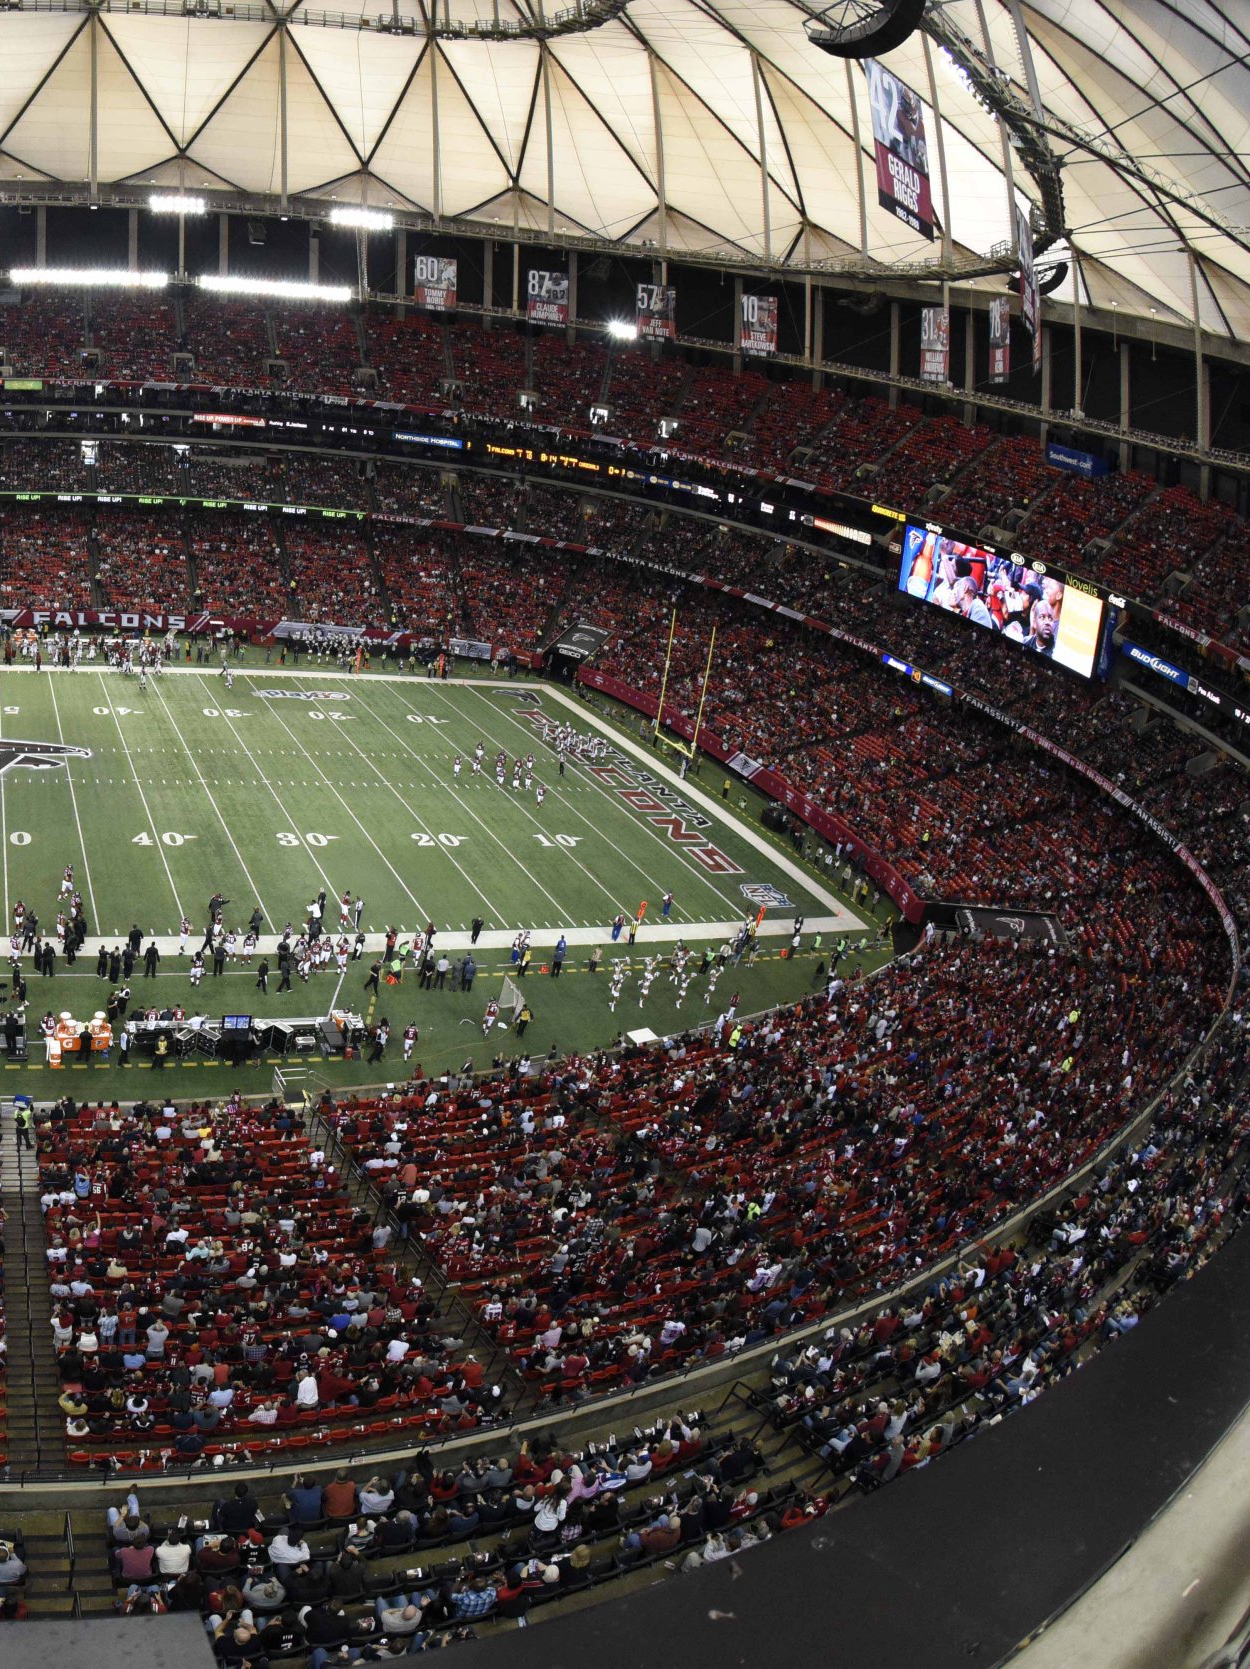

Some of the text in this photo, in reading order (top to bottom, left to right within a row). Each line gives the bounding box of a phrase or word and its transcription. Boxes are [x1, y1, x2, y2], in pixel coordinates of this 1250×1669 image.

[888, 153, 920, 193] GERALD
[893, 179, 919, 213] RIGGS
[416, 256, 438, 281] 60
[528, 270, 550, 296] 87
[424, 288, 447, 298] TOMMY
[426, 296, 445, 305] NOBIS
[637, 284, 658, 309] 57
[530, 310, 564, 322] HUMPHREY
[536, 303, 558, 313] CLAUDE
[741, 295, 758, 322] 10
[642, 325, 670, 337] VAN NOTE
[650, 319, 663, 328] JEFF
[922, 309, 934, 340] 31
[750, 331, 767, 341] STEVE
[741, 339, 775, 351] BARTKOWSKI
[230, 387, 316, 400] ATLANTA FALCONS
[214, 415, 234, 423] POWER
[460, 412, 544, 430] ATLANTA FALCONS
[395, 433, 460, 447] NORTHSIDE HOSPITAL
[540, 453, 557, 462] 8:14
[666, 449, 743, 472] ATLANTA FALCONS
[371, 514, 415, 524] FALCONS
[925, 522, 943, 535] xfinity
[605, 552, 687, 578] ATLANTA FALCONS
[1065, 573, 1098, 597] Novelis
[32, 611, 187, 628] FALCONS
[1158, 615, 1196, 638] FALCONS
[842, 634, 878, 654] ATLANTA
[558, 648, 581, 659] GEICO
[1130, 648, 1180, 679] BUD LIGHT
[966, 695, 1020, 730] FAN ASSIST!
[603, 746, 712, 828] TLANTA
[1131, 804, 1176, 847] FAN ASSIST!
[131, 831, 185, 847] 40
[275, 832, 329, 847] 30
[410, 833, 461, 848] 20
[532, 833, 578, 848] 10
